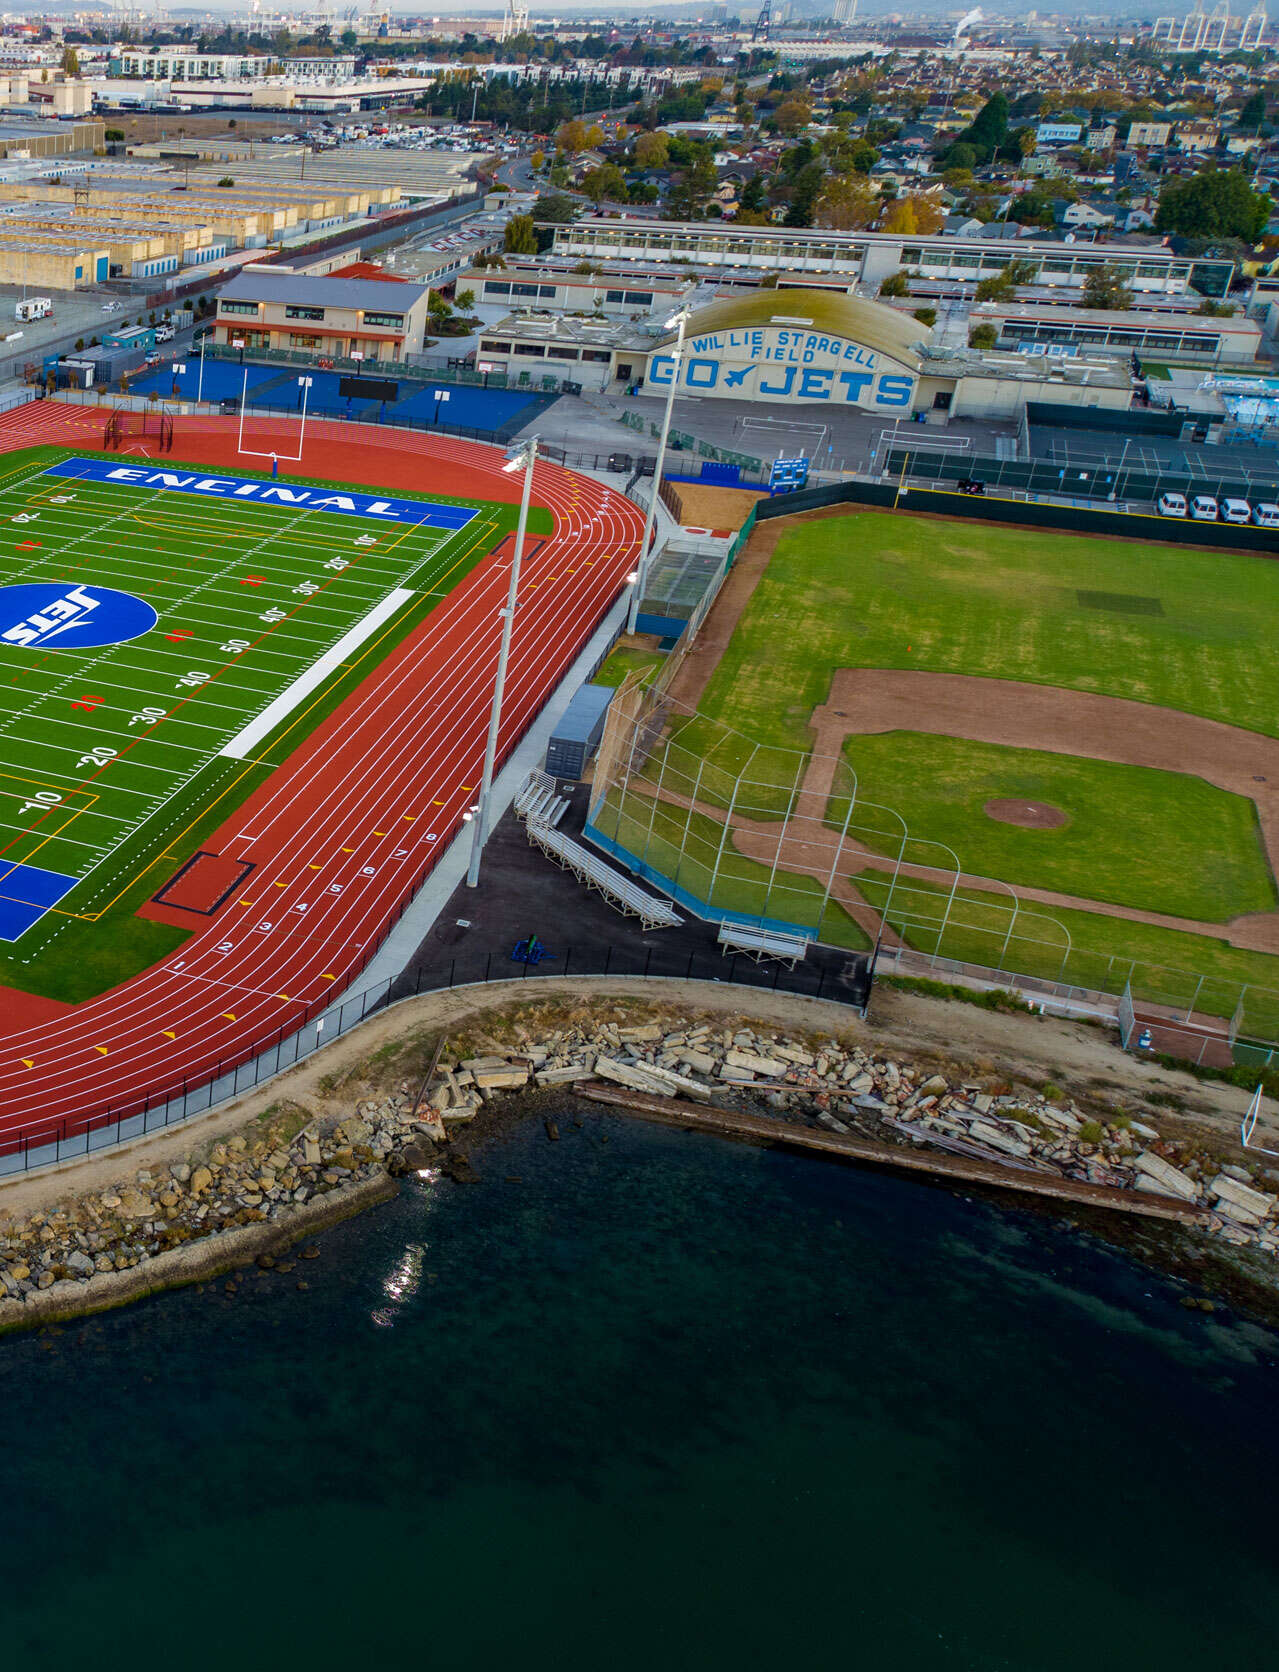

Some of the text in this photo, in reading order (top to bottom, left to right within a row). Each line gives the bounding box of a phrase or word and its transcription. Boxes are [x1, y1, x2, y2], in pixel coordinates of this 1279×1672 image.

[692, 331, 876, 369] WILLIE STARGELL
[751, 346, 815, 363] FIELD
[649, 355, 914, 406] GO JETS
[105, 468, 401, 516] ENCINAL
[323, 558, 349, 570] 20
[292, 583, 320, 595] 30
[1, 585, 101, 646] JETS
[259, 610, 287, 623] 40
[219, 639, 251, 654] 50
[180, 671, 211, 687] 40
[71, 695, 105, 712] 20
[132, 707, 167, 725] 30
[80, 747, 118, 767] 20
[24, 791, 62, 811] 10
[394, 849, 409, 857] 7
[362, 866, 376, 875] 6
[330, 884, 344, 893] 5
[295, 903, 309, 912] 4
[259, 921, 273, 931] 3
[218, 942, 233, 952] 2
